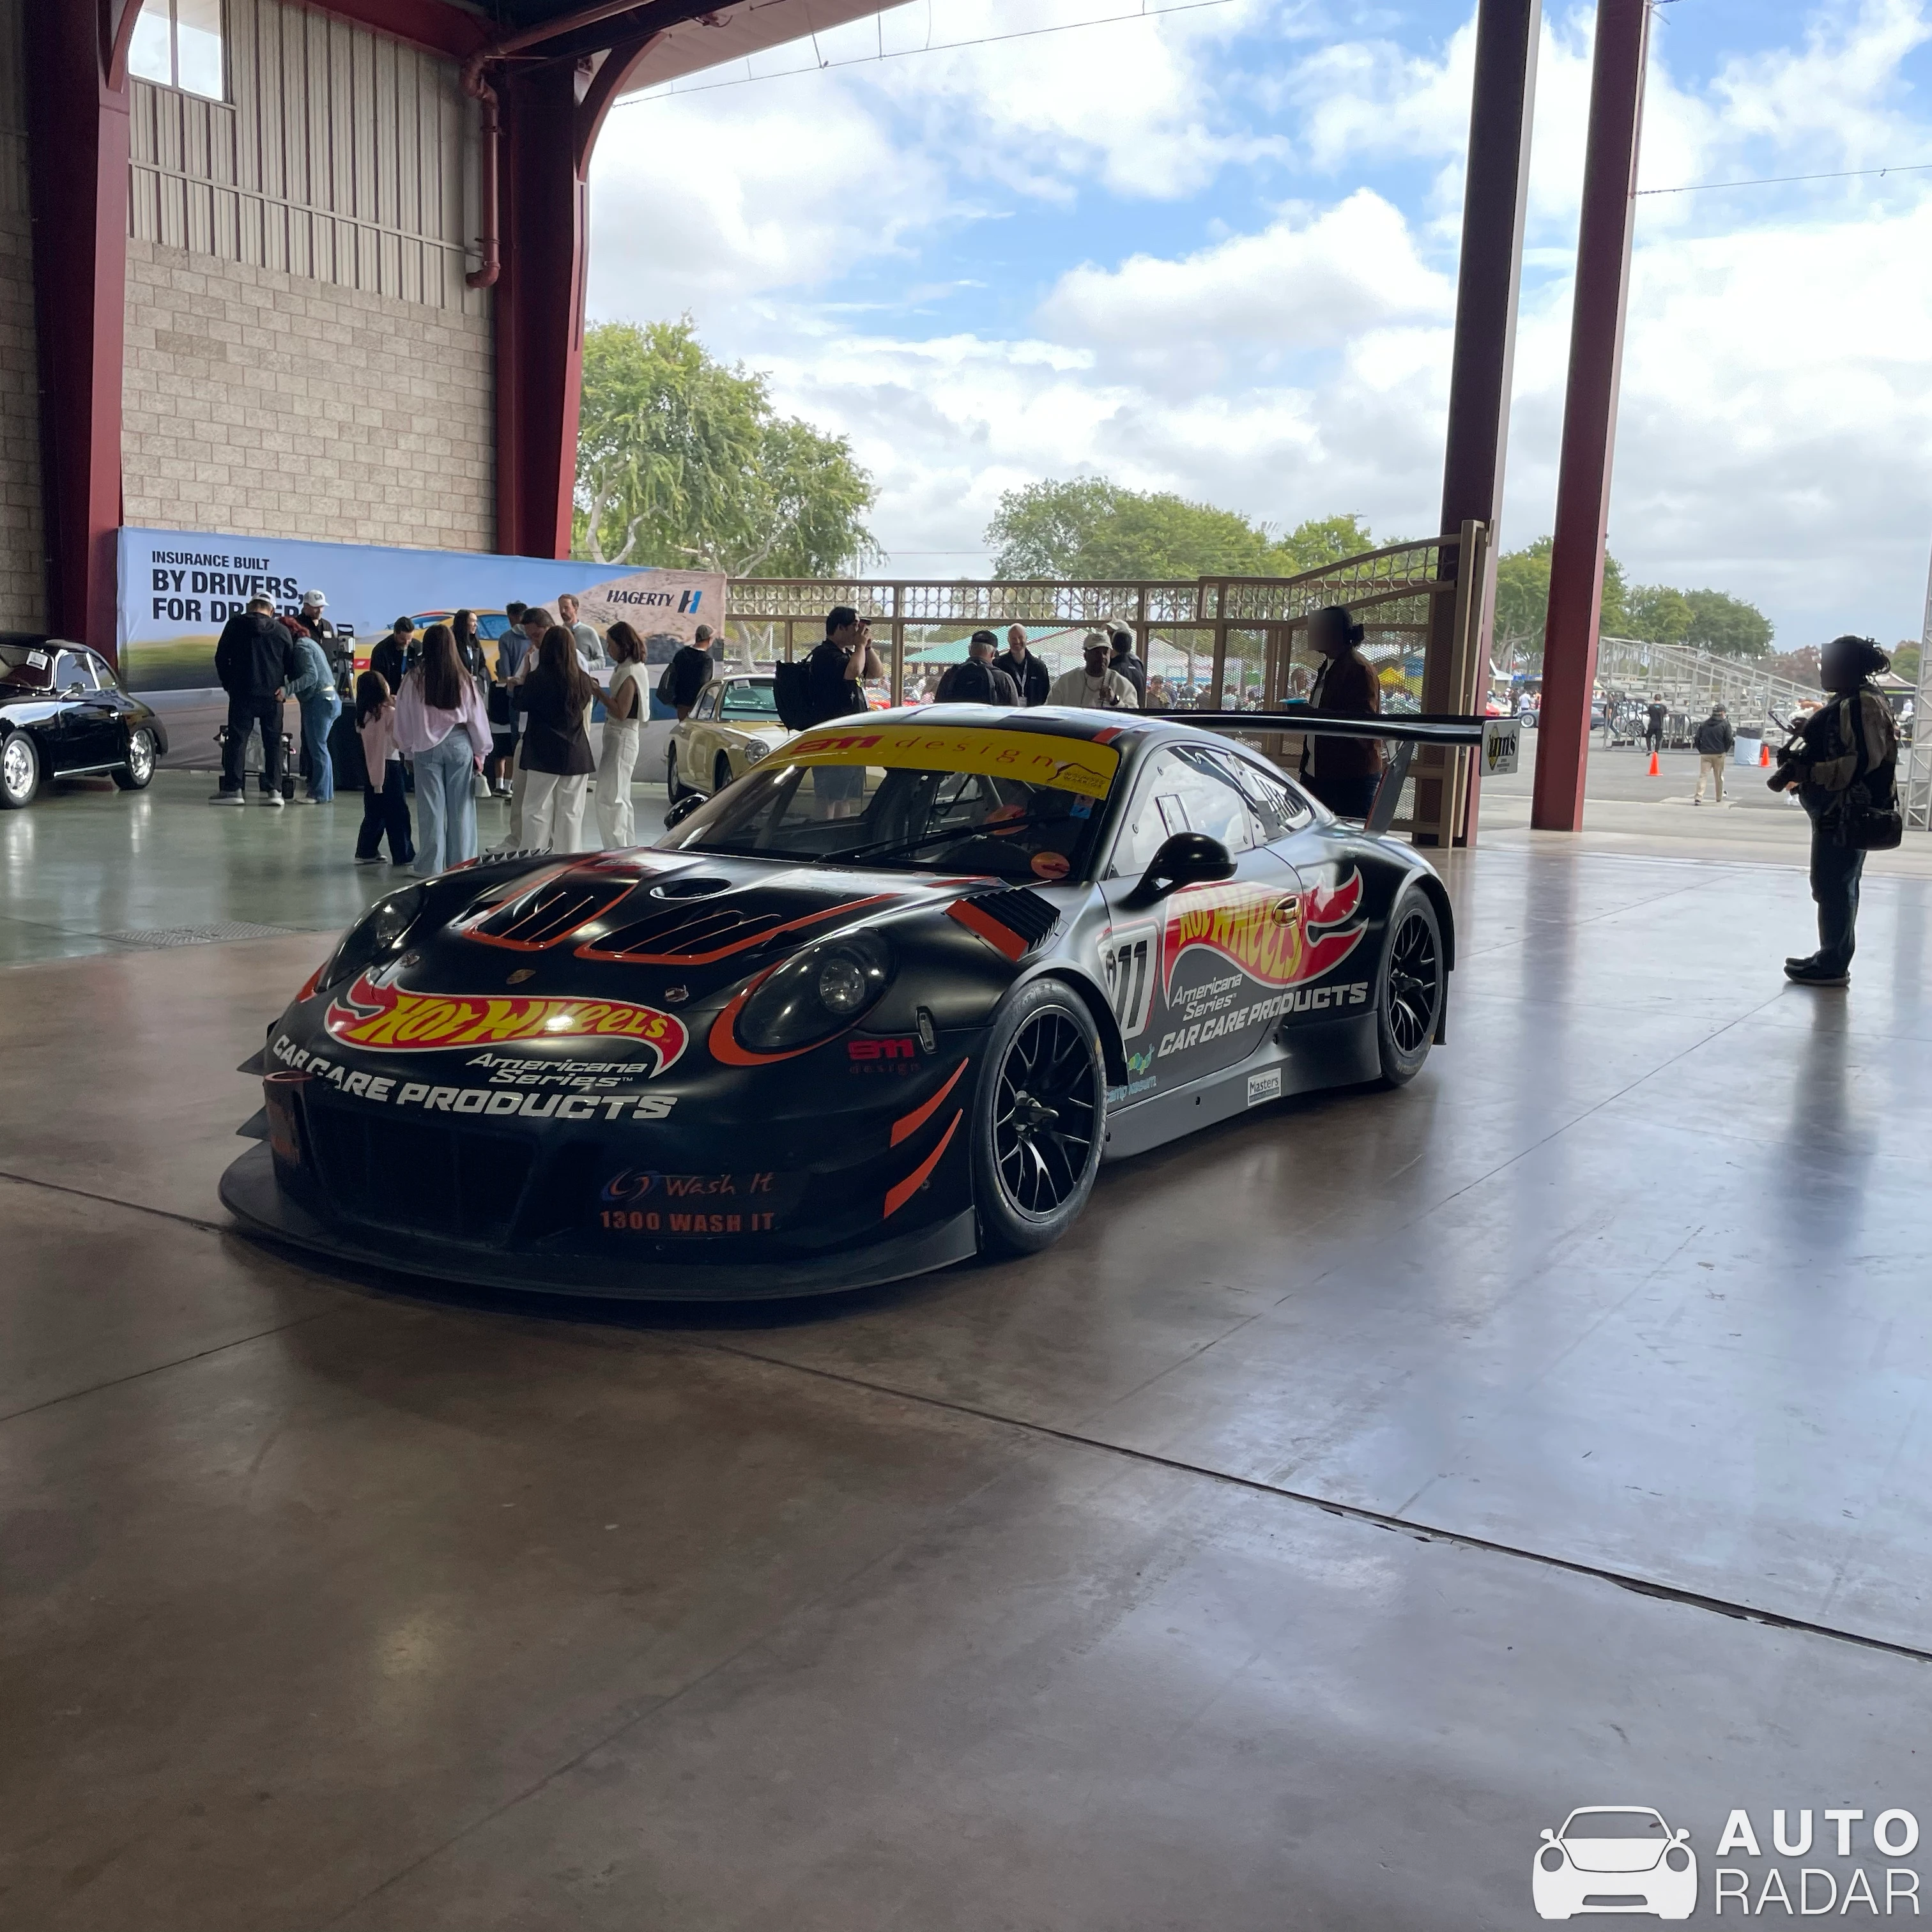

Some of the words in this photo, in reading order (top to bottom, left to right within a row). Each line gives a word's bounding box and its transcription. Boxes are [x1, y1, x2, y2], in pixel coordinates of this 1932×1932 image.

[152, 551, 229, 567] INSURANCE
[234, 556, 270, 571] BUILT
[153, 569, 186, 592] BY
[192, 571, 303, 604] DRIVERS,
[606, 590, 675, 606] HAGERTY
[153, 597, 202, 622] FOR
[895, 736, 1054, 767] design
[1171, 973, 1243, 1007] Americana
[1158, 1023, 1200, 1057] CAR
[1199, 1006, 1249, 1043] CARE
[1247, 981, 1368, 1026] PRODUCTS
[848, 1038, 914, 1060] 911
[466, 1053, 648, 1073] Americana
[849, 1062, 921, 1077] design
[273, 1034, 310, 1069] CAR
[305, 1057, 396, 1102] CARE
[397, 1084, 677, 1119] PRODUCTS
[1250, 1077, 1278, 1094] Masters
[666, 1174, 735, 1196] Wash
[749, 1172, 775, 1194] It
[601, 1211, 661, 1230] 1300
[670, 1213, 742, 1232] WASH
[751, 1212, 774, 1230] IT
